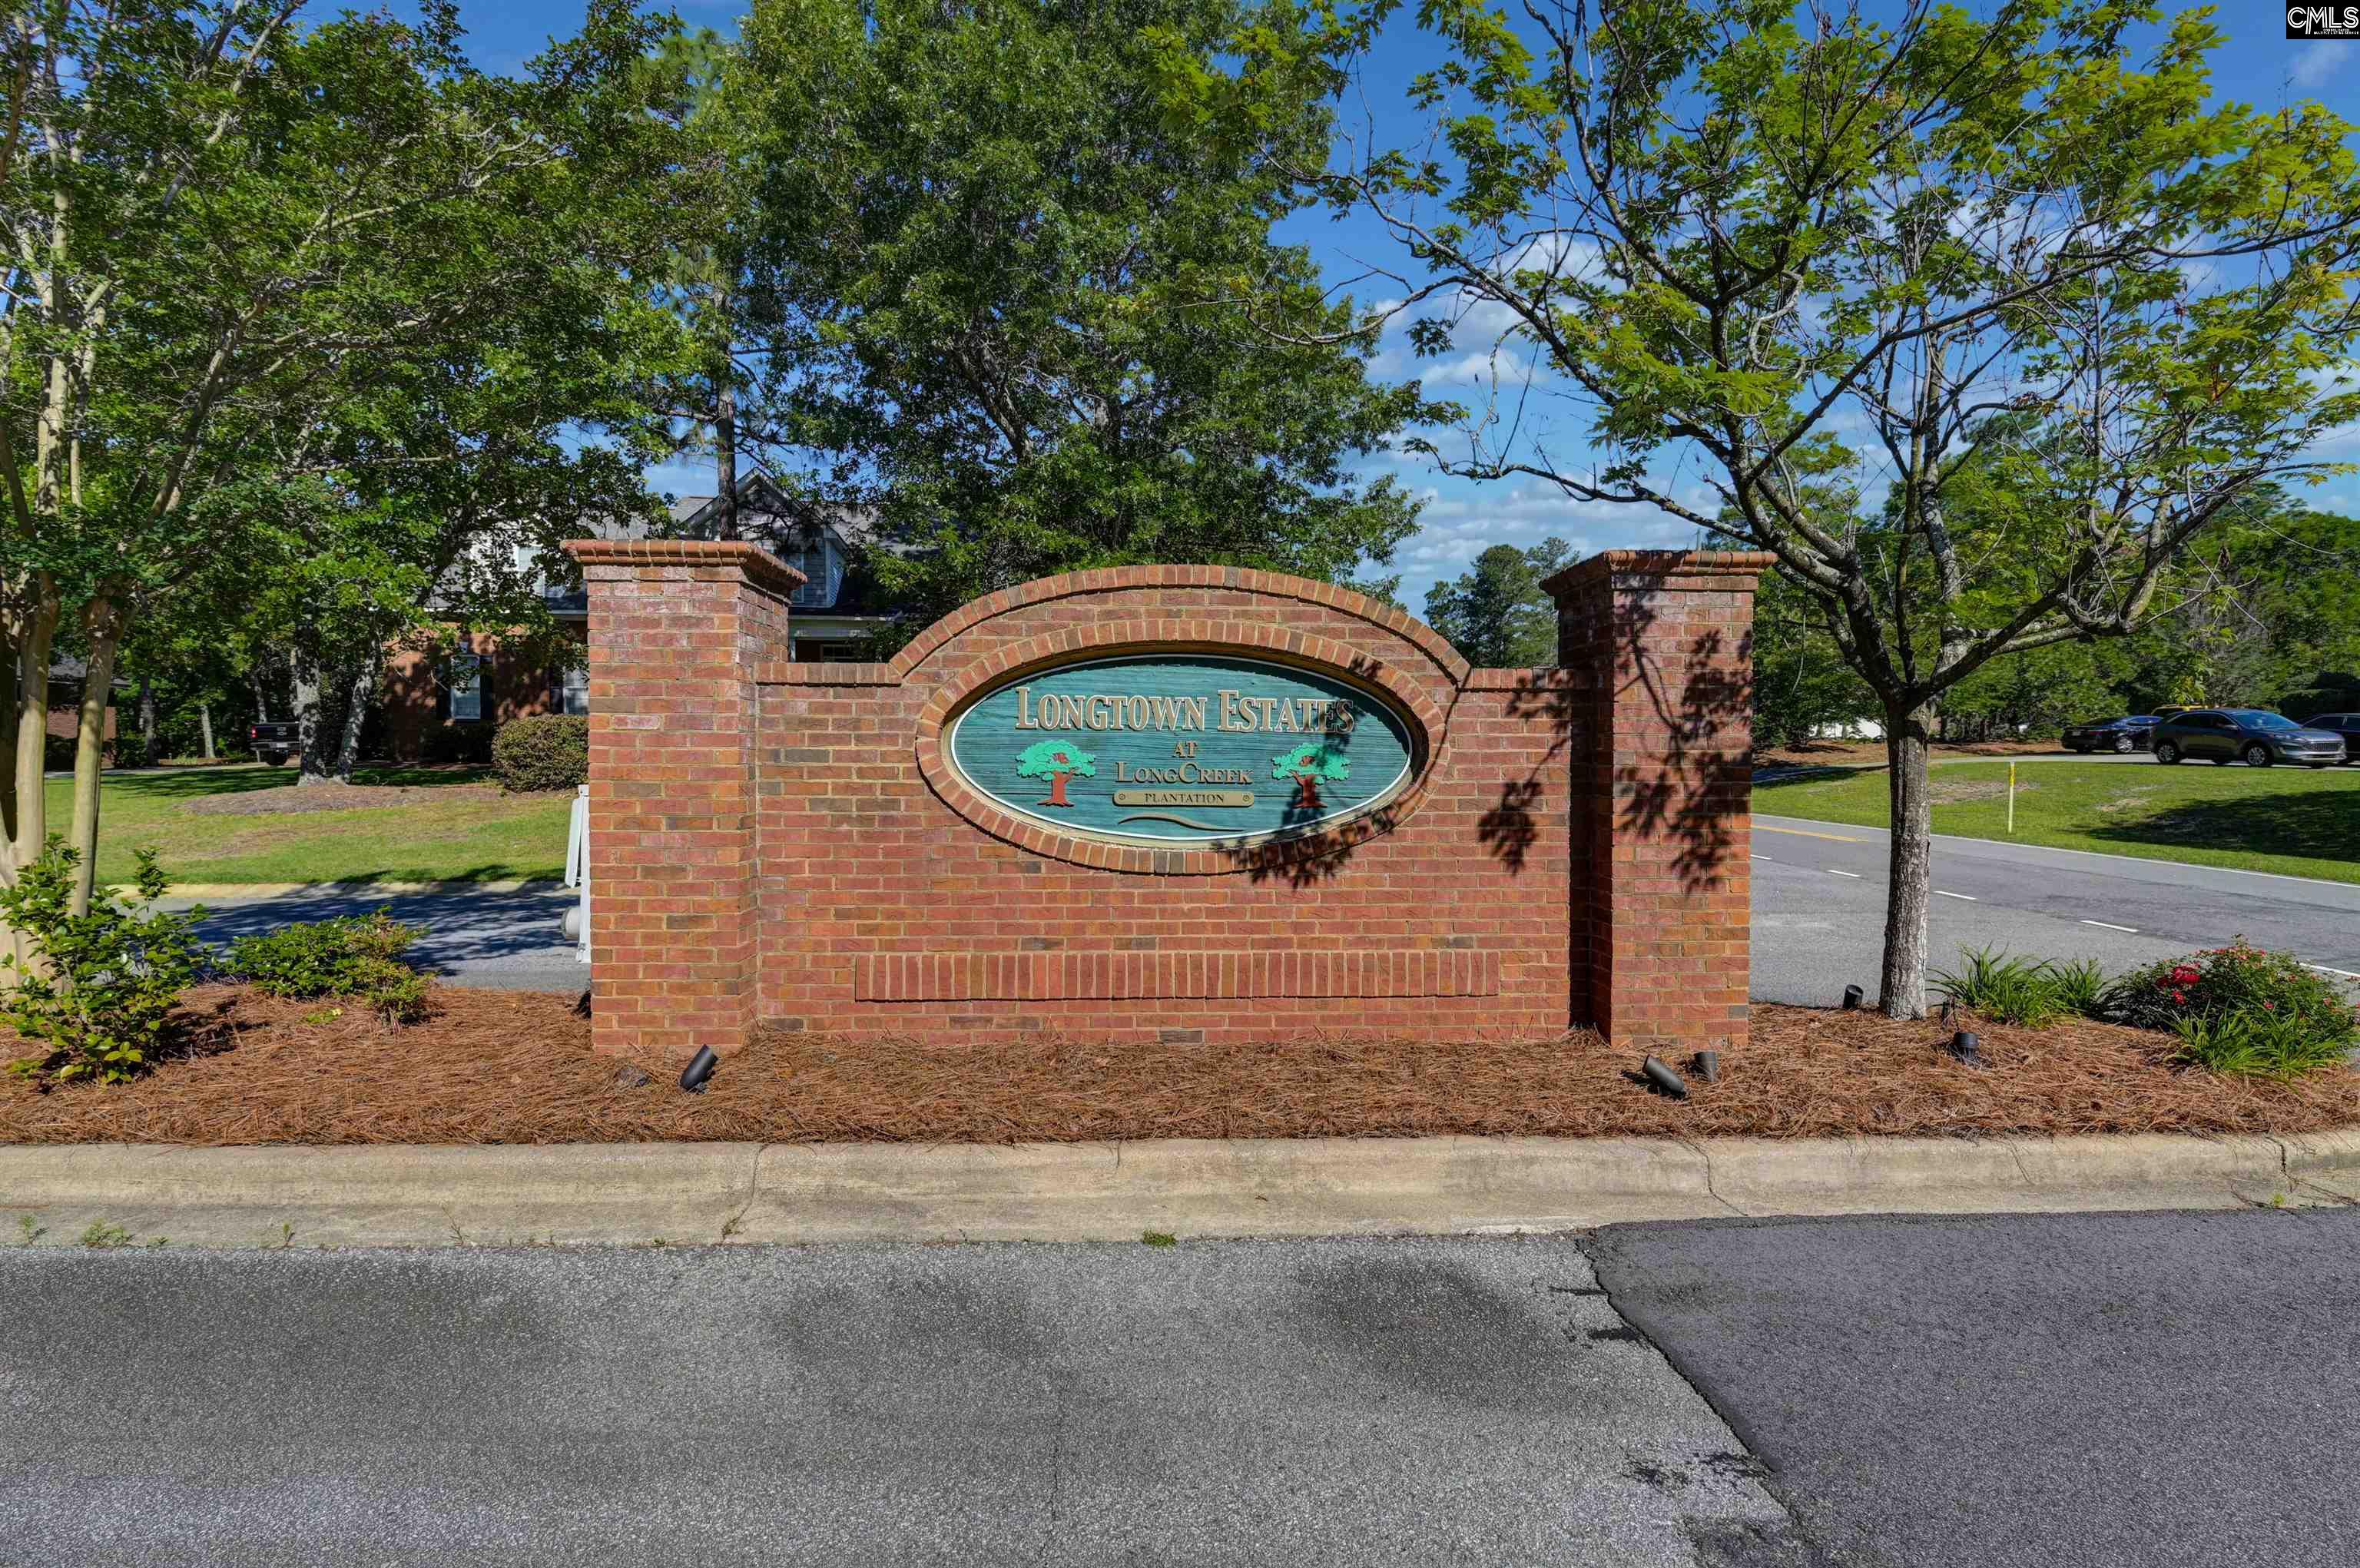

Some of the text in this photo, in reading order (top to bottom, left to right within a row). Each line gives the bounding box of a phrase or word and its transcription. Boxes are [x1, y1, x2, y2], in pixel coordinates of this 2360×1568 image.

[1015, 686, 1354, 734] LONGTOWN ESTATES
[1172, 740, 1198, 758] AT
[1144, 792, 1225, 804] PLANTATION
